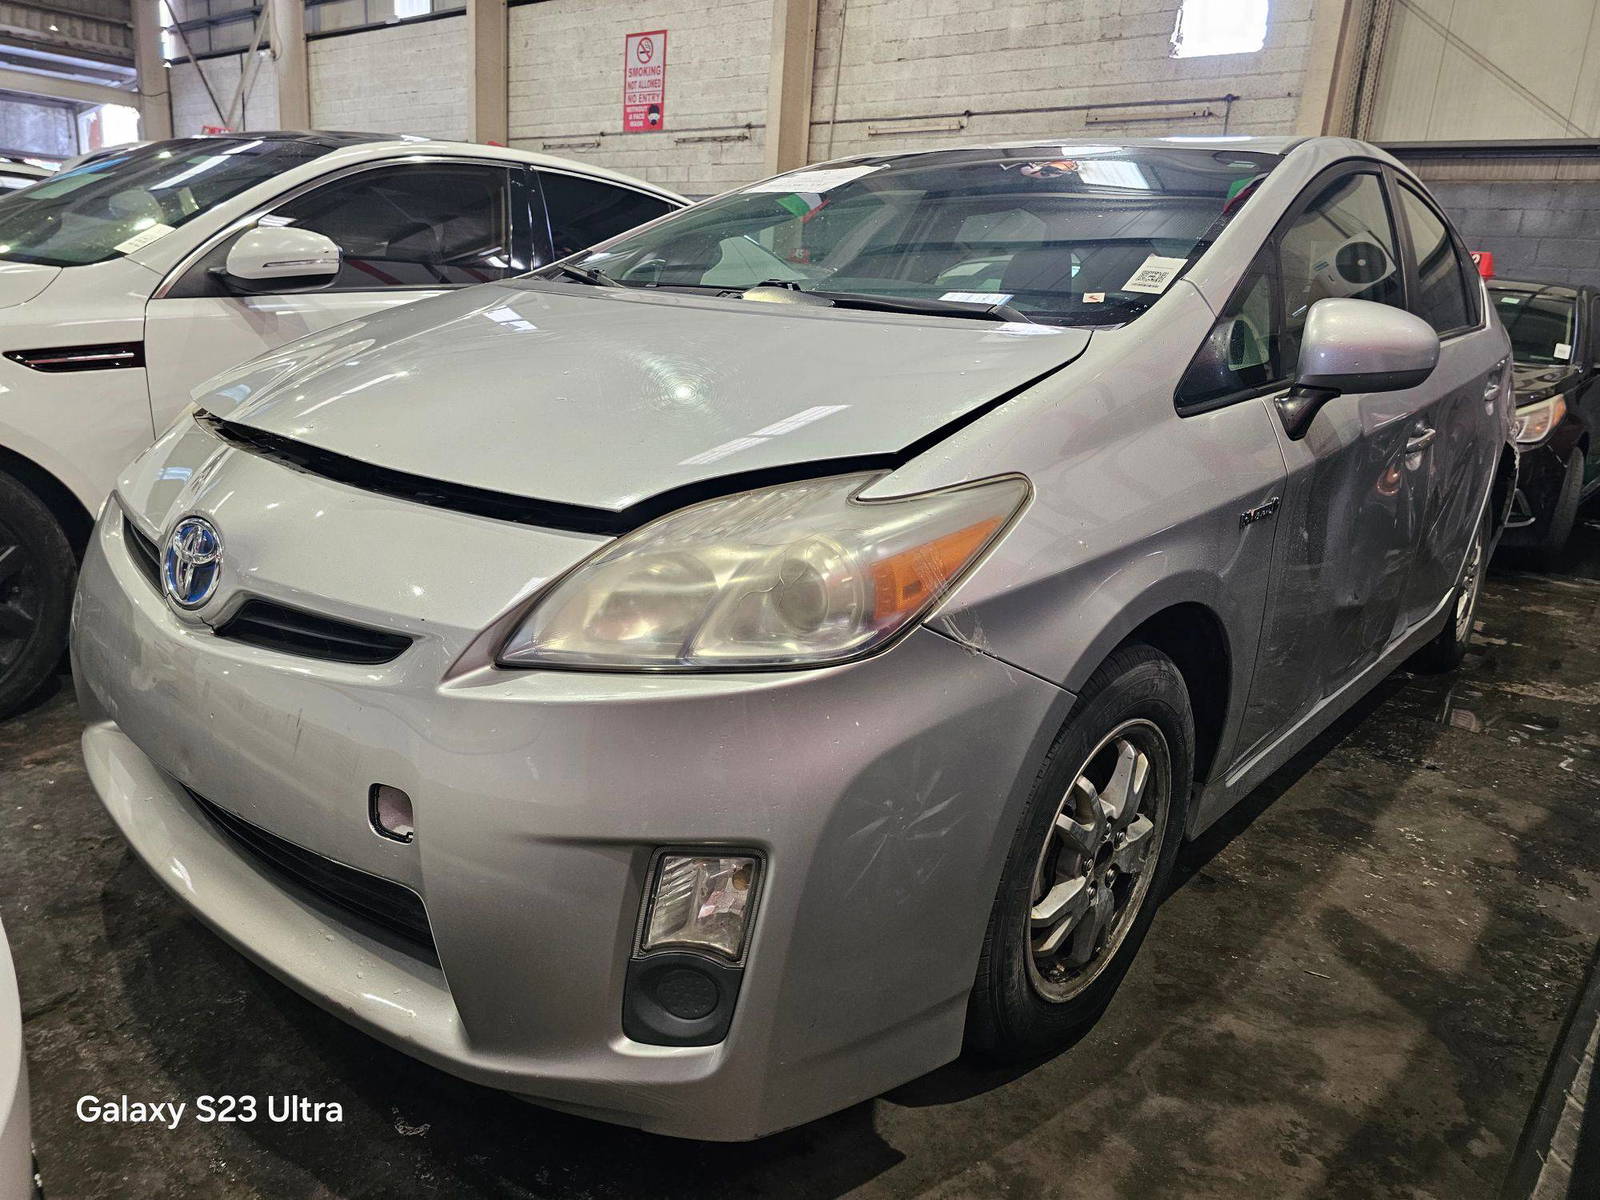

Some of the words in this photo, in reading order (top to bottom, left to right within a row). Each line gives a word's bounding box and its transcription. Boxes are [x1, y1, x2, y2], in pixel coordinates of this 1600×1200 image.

[628, 66, 661, 77] SMOKING
[628, 81, 637, 90] NOT
[639, 79, 661, 88] ALLOWED
[628, 94, 637, 103] NO
[639, 93, 660, 102] ENTRY
